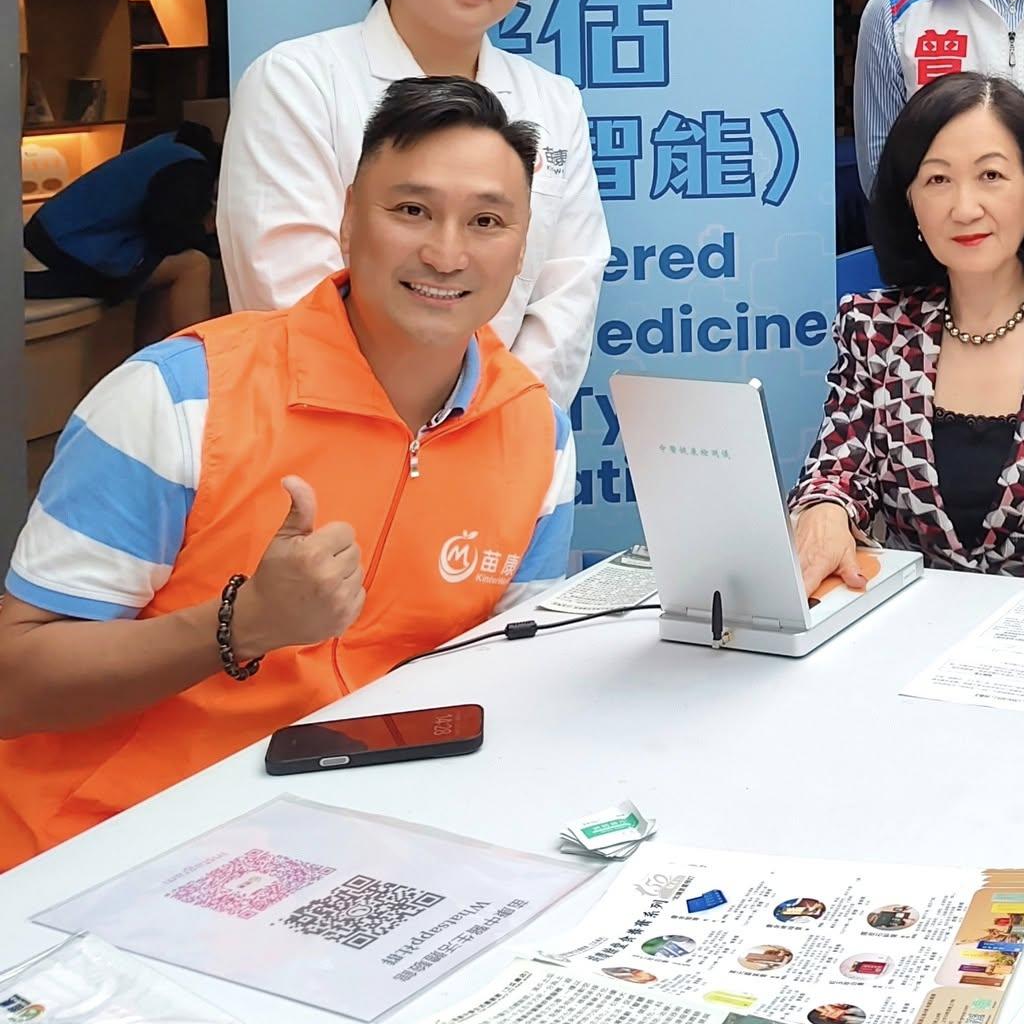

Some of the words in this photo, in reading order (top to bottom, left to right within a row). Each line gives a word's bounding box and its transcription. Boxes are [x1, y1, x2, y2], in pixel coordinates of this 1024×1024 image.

[914, 28, 968, 86] 曾
[602, 231, 736, 280] ered
[596, 302, 827, 357] edicine
